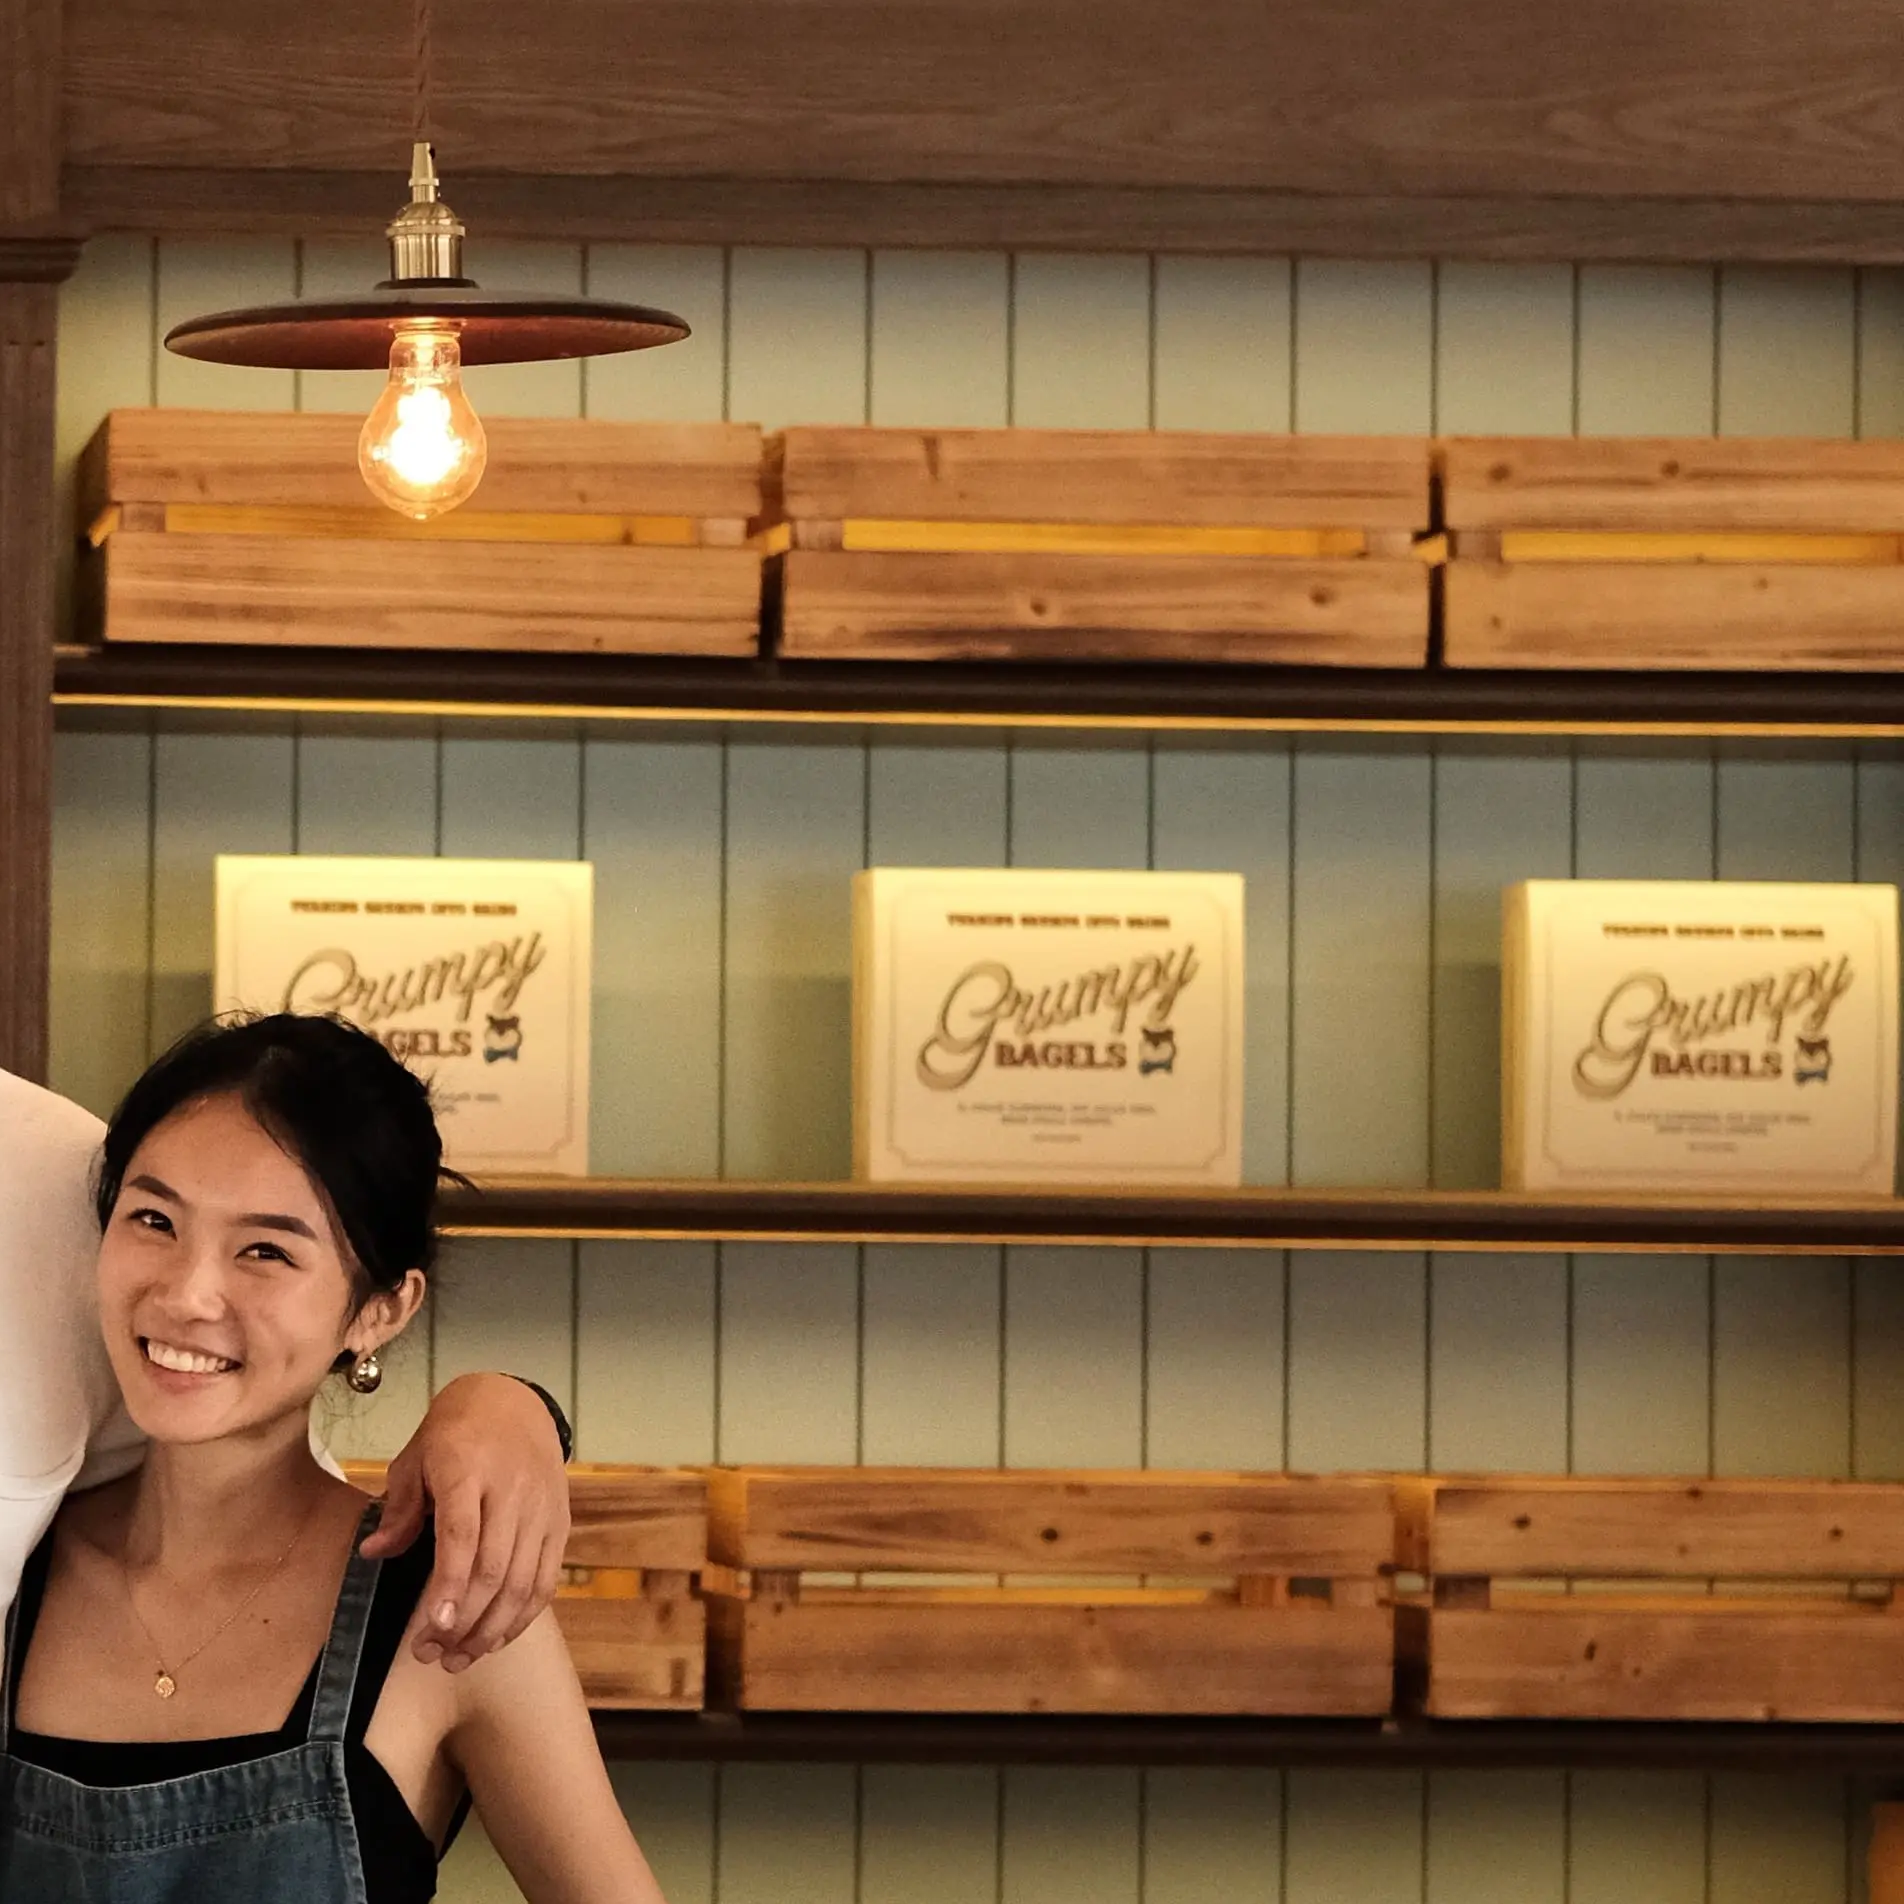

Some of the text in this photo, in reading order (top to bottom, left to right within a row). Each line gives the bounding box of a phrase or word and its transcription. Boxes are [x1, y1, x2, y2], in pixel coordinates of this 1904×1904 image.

[915, 944, 1200, 1092] Grumpy
[996, 1040, 1127, 1069] BAGELS
[1571, 953, 1854, 1102] Grumpy
[1650, 1048, 1783, 1079] BAGELS
